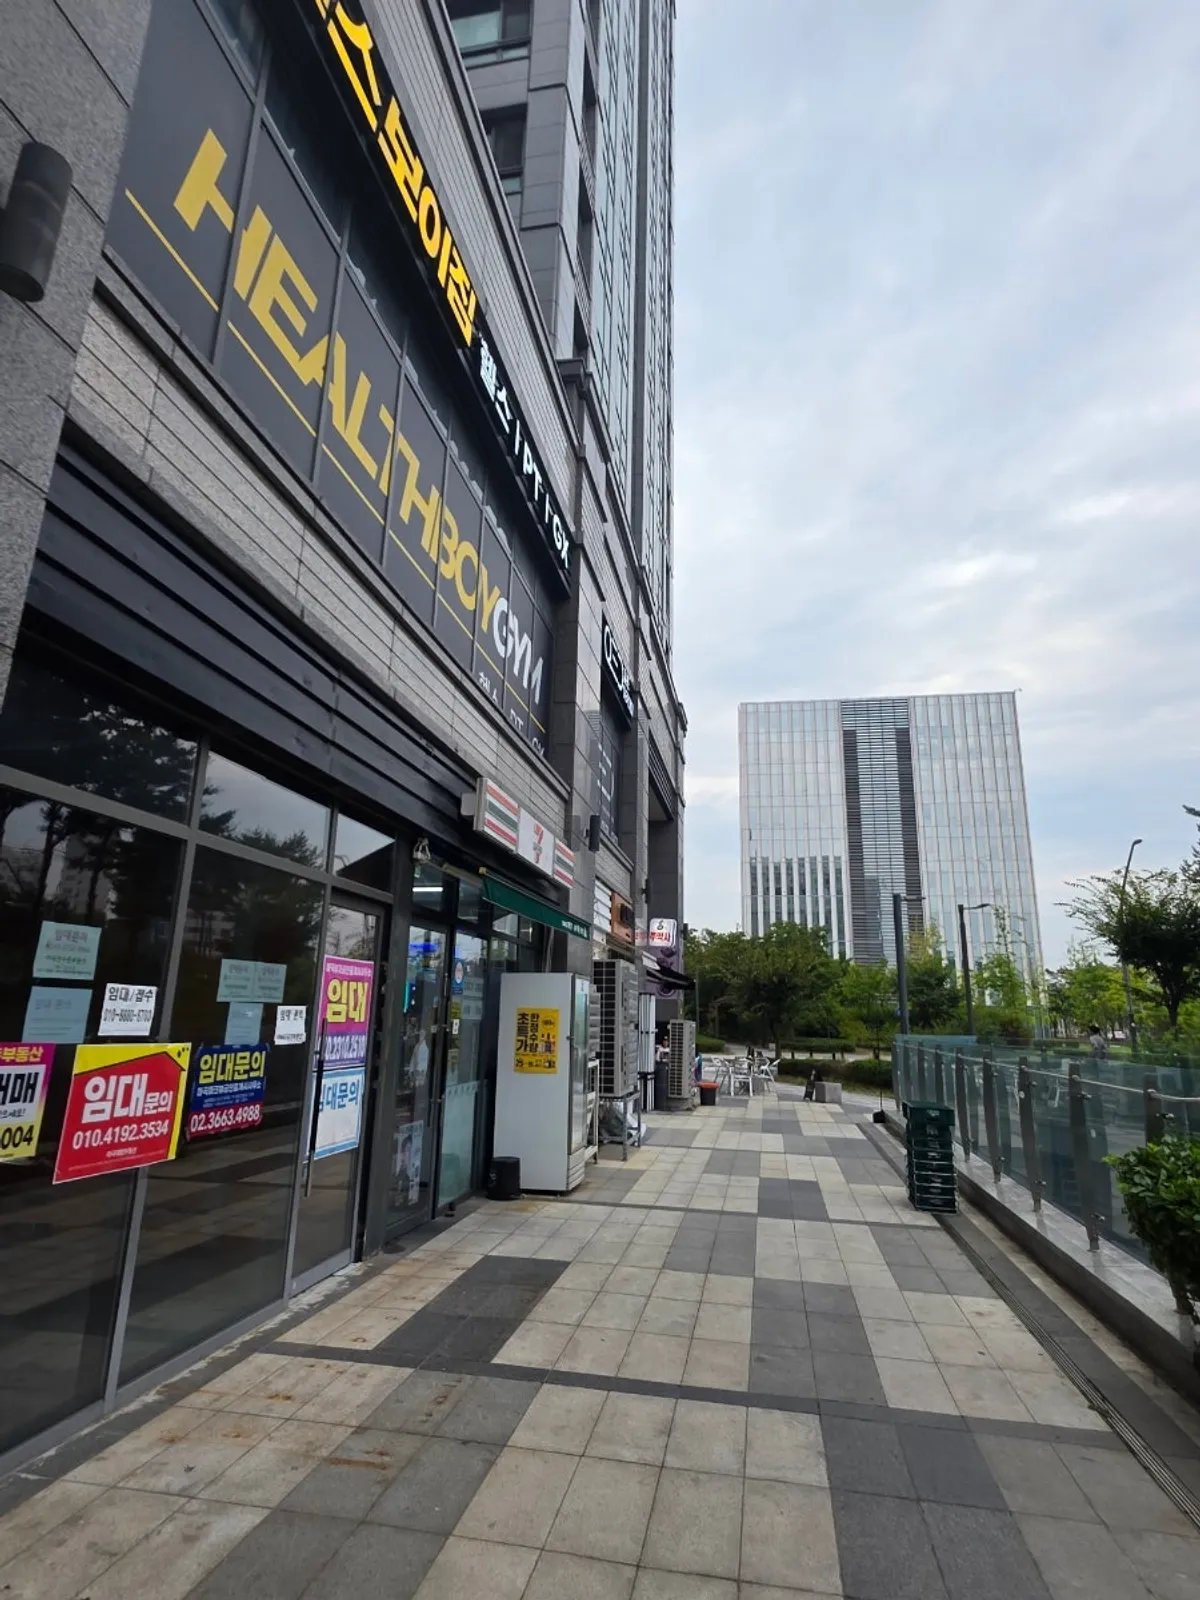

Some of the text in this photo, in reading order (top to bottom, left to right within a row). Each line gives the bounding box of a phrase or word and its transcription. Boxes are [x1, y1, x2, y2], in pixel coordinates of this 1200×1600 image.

[315, 0, 476, 347] 스보이짐
[327, 978, 369, 1024] 임대
[0, 1046, 44, 1063] 부동산
[199, 1051, 266, 1084] 임대문의
[190, 1104, 260, 1132] 02.3663.4988
[72, 1119, 170, 1150] 010.4192.3534
